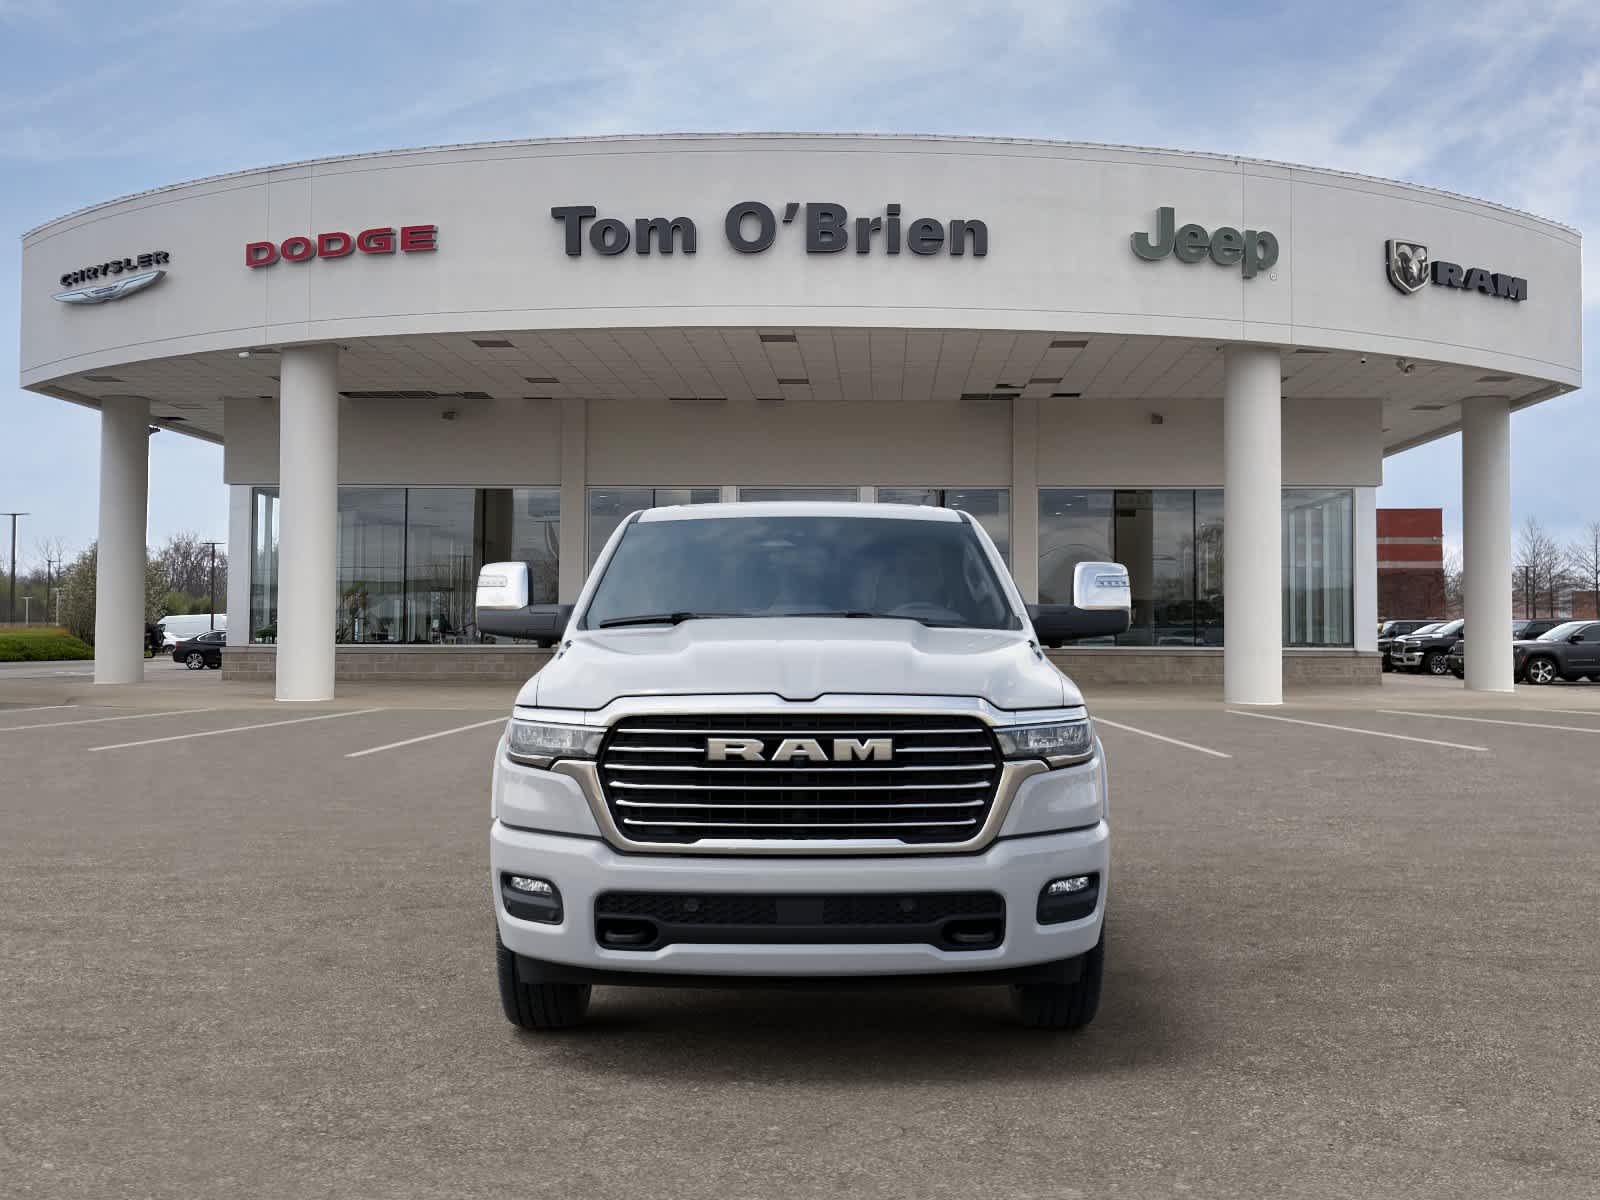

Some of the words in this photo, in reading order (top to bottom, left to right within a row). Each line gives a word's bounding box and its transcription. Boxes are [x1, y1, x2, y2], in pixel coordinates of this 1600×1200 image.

[246, 225, 438, 269] DODGE
[551, 205, 697, 256] Tom
[724, 200, 988, 257] O'Brien
[1131, 206, 1280, 279] Jeep
[60, 250, 170, 287] CHRYSLER
[1431, 260, 1528, 301] RAM
[707, 737, 893, 761] RAM
